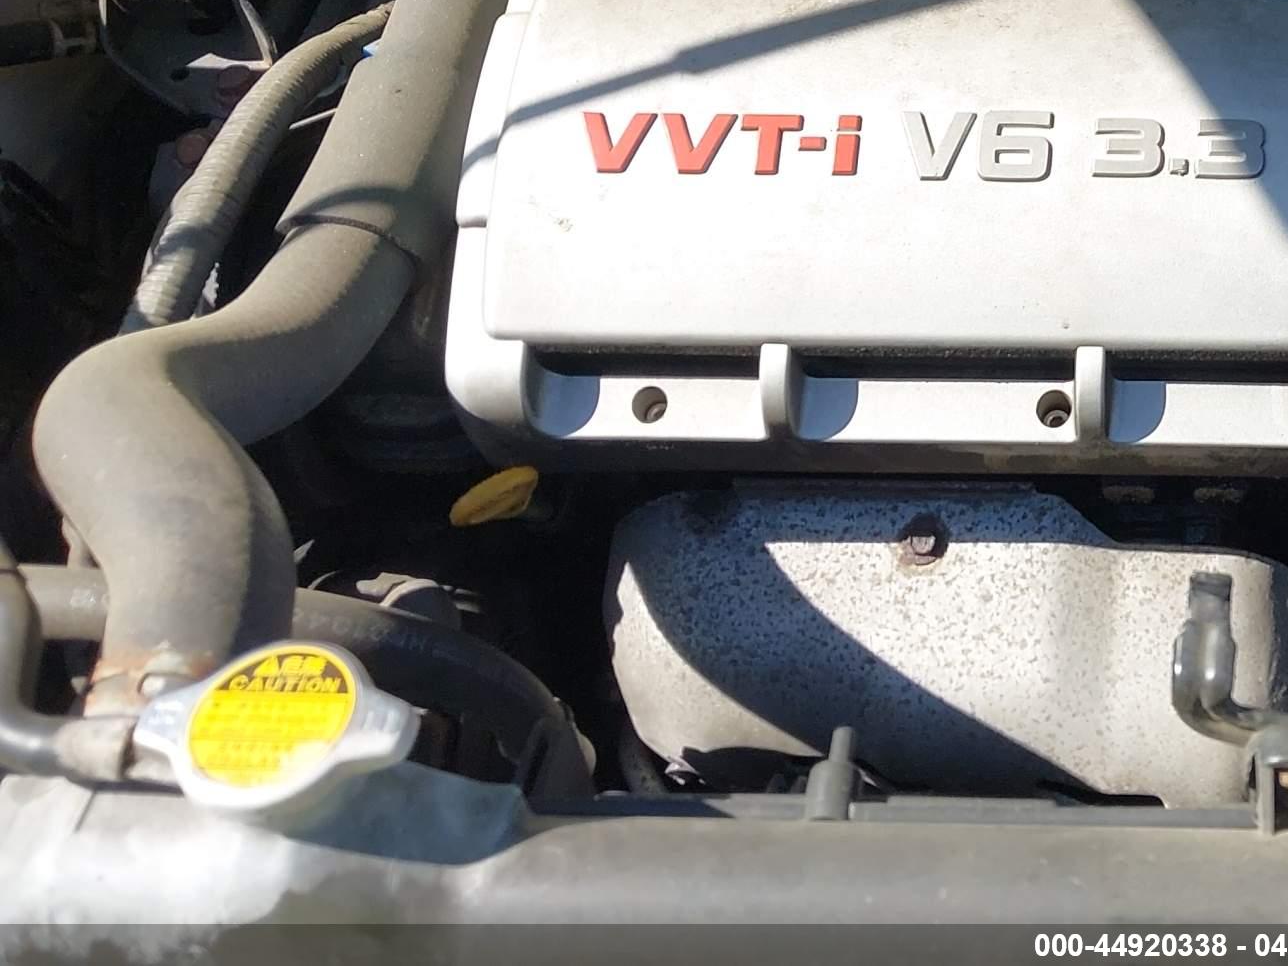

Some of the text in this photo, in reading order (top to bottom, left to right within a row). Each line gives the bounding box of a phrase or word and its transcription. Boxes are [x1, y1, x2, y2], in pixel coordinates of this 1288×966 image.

[584, 110, 1267, 182] VVT-i V6 3.3
[229, 674, 342, 693] CAUTION
